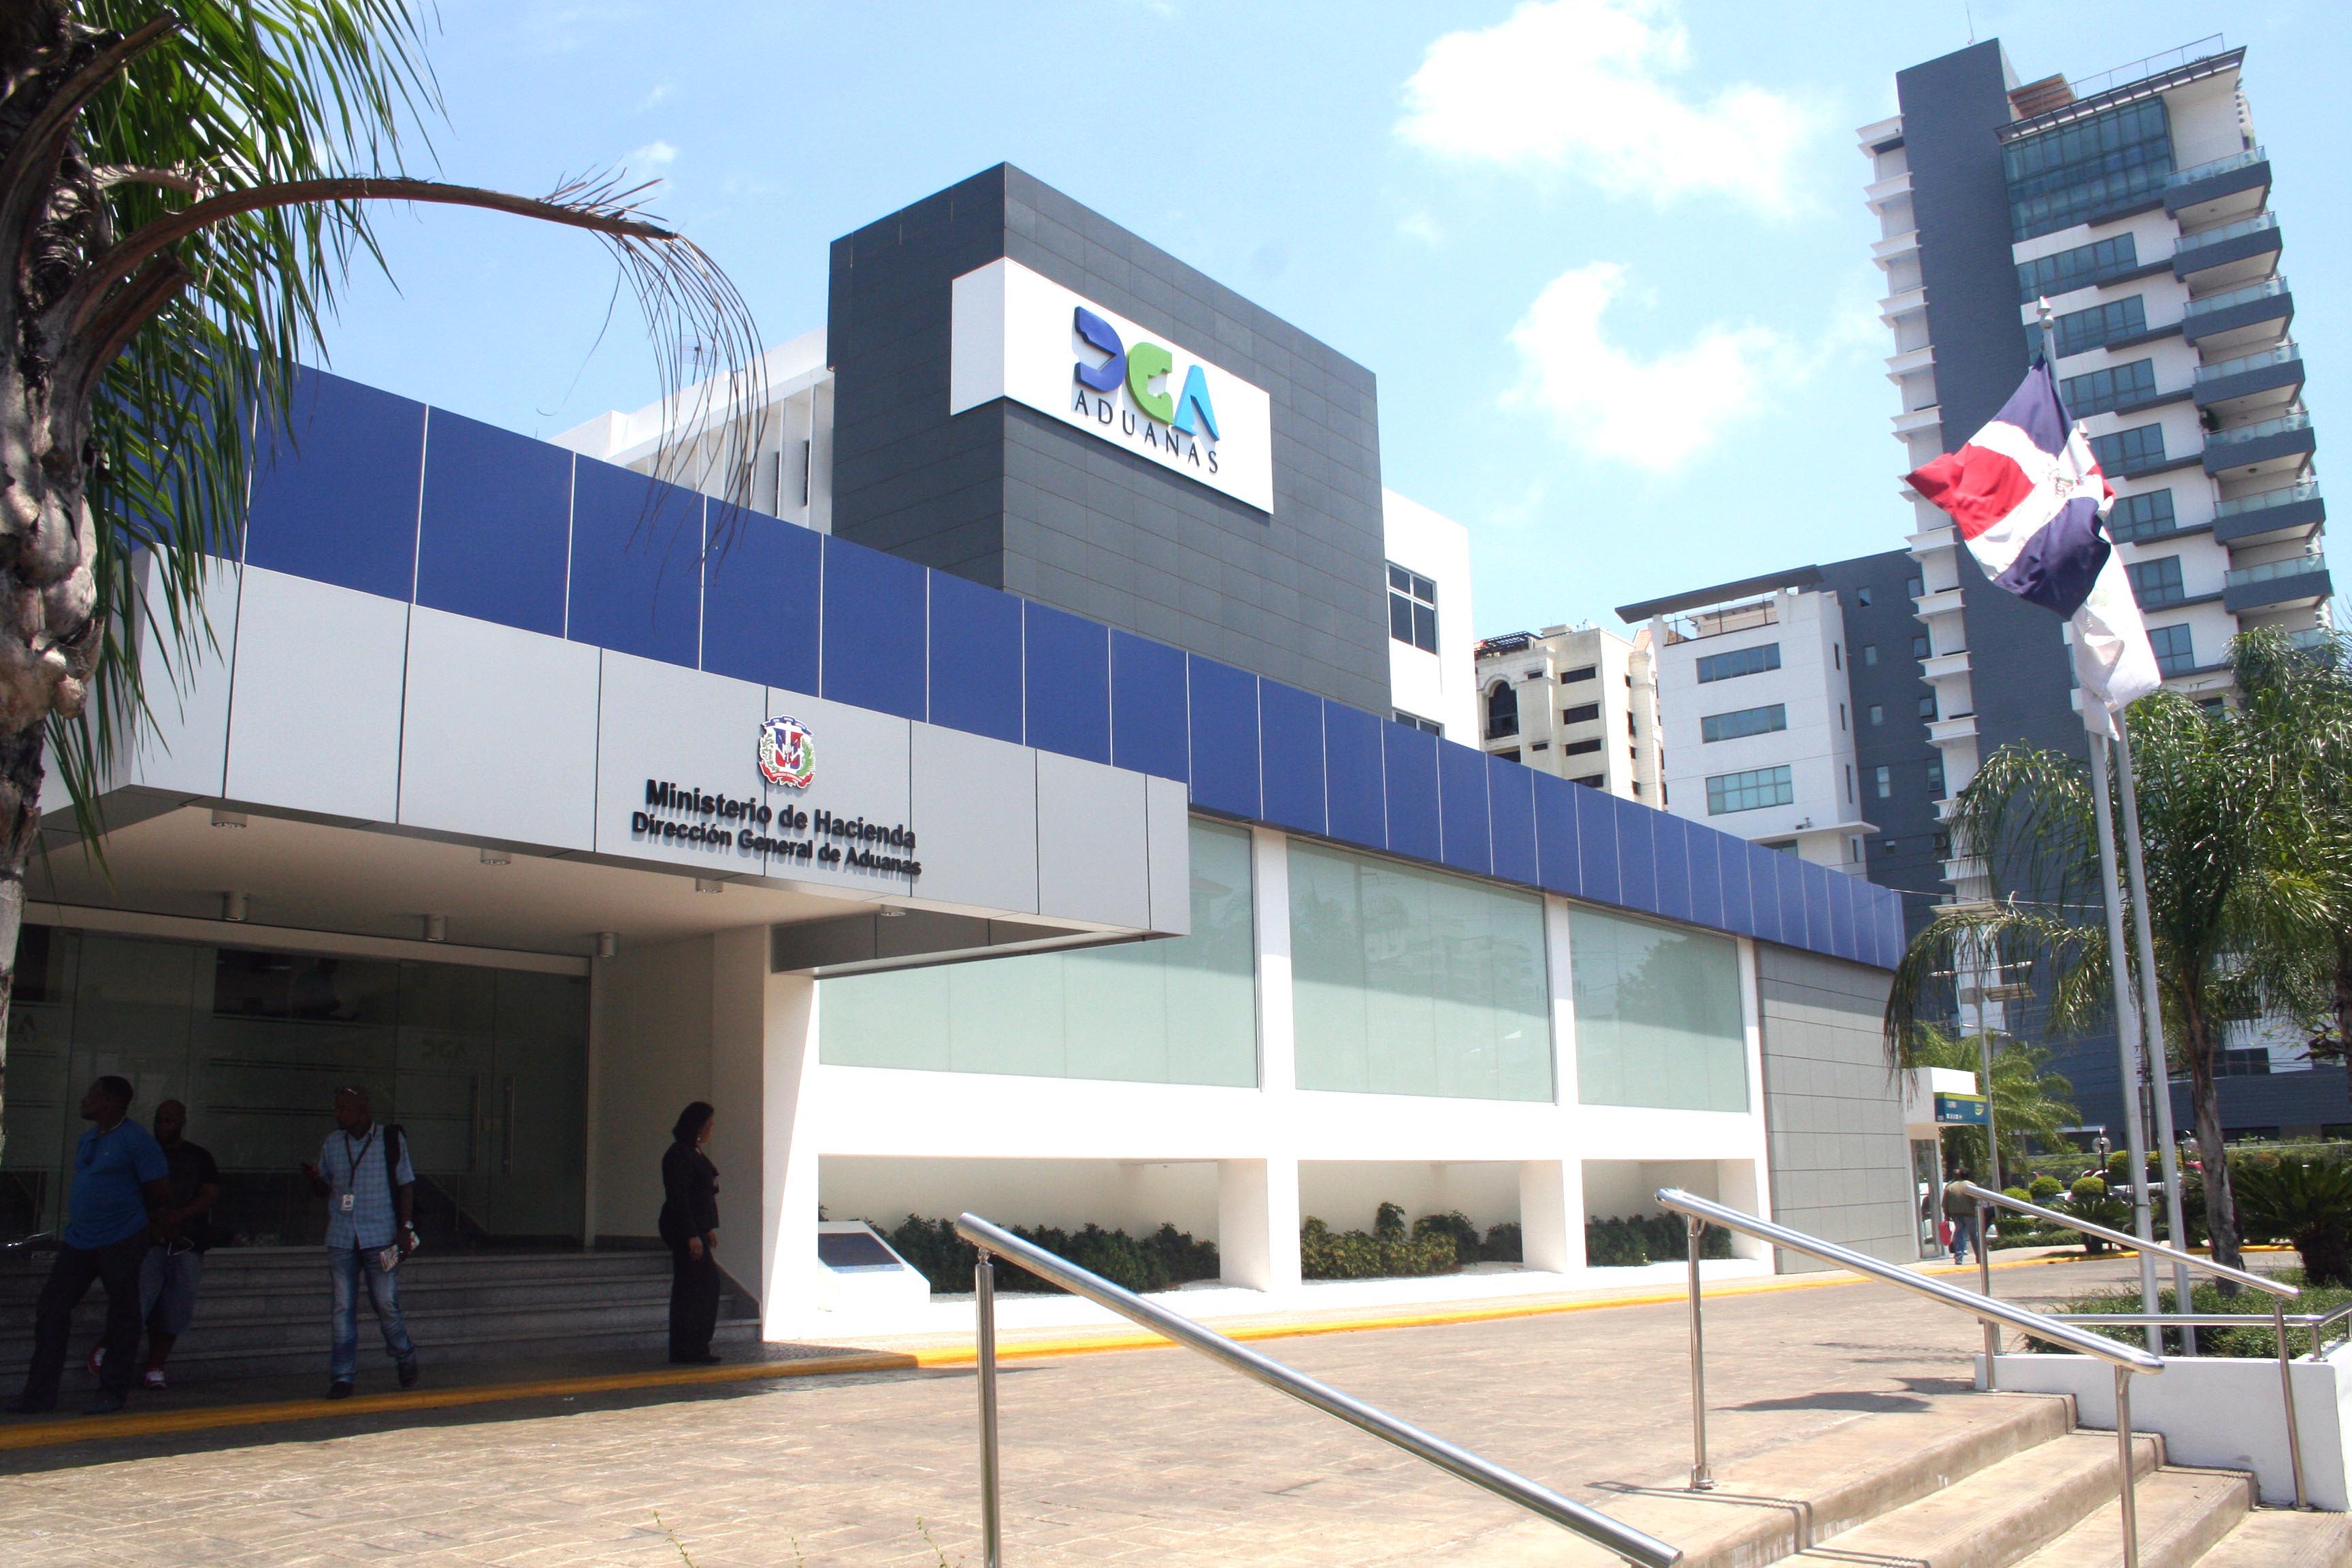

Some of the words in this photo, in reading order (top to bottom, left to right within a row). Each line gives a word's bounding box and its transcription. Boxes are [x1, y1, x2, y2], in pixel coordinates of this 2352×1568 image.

[1075, 389, 1218, 474] ADUANAS
[632, 811, 733, 847] Dirección
[737, 828, 813, 859] General
[817, 842, 842, 863] de
[845, 846, 922, 876] Aduanas
[646, 779, 773, 824] Ministerio
[778, 804, 808, 830] de
[814, 808, 916, 849] Hacienda
